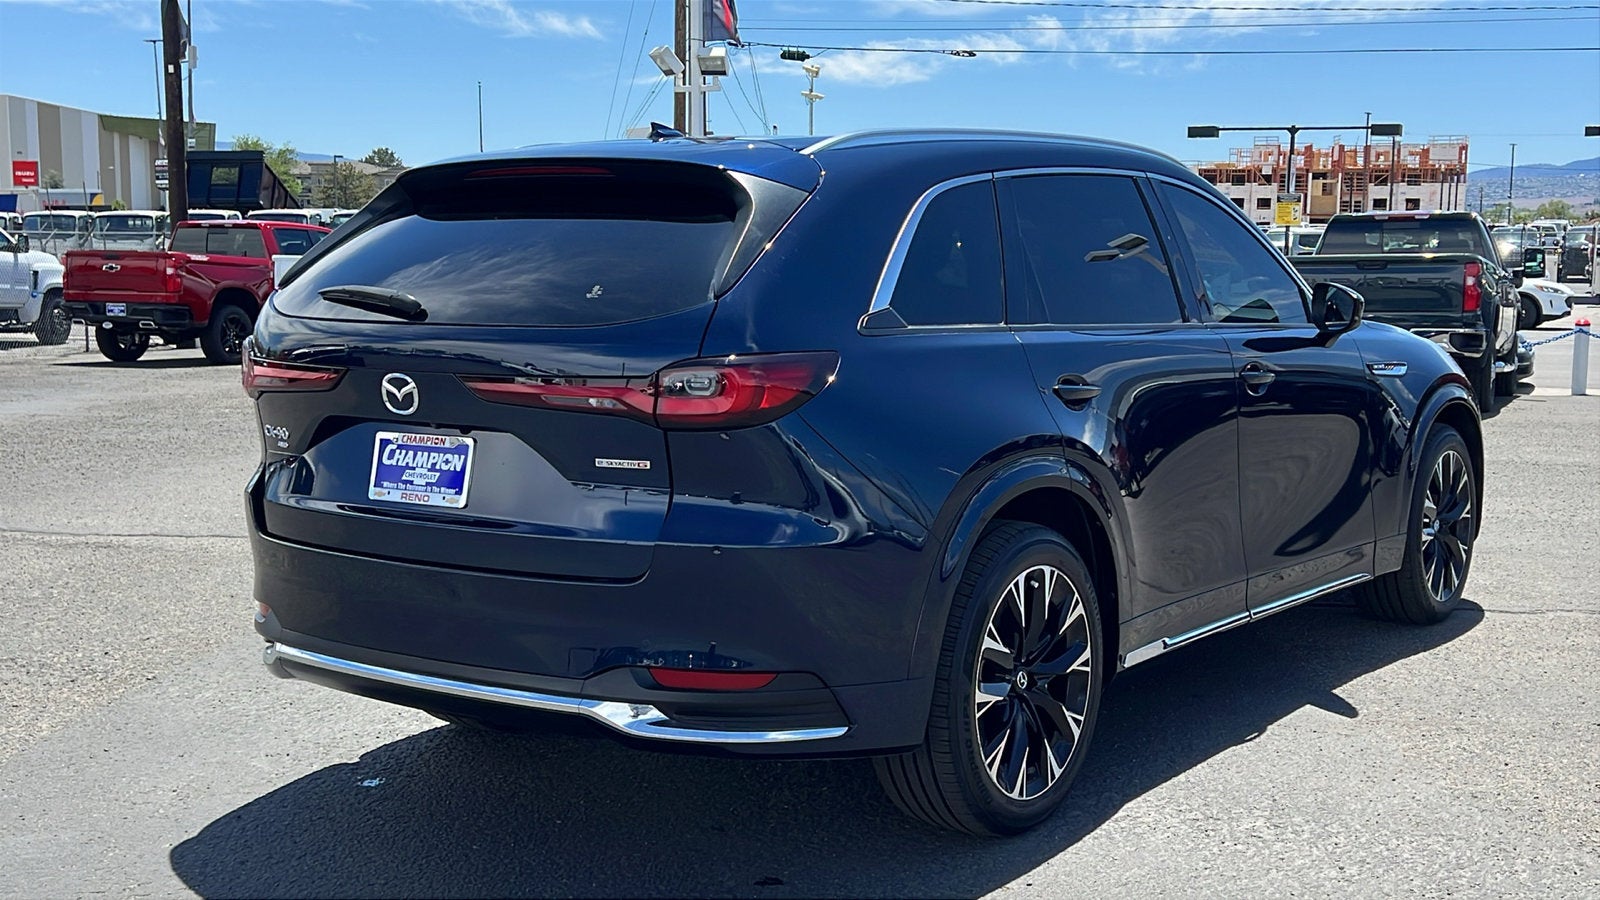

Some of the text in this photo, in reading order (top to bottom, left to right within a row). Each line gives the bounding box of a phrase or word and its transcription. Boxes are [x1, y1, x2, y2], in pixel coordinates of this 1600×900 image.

[401, 434, 447, 446] CHAMPION
[382, 443, 465, 472] CHAMPION
[404, 471, 438, 481] CHEVROLET
[400, 492, 430, 503] RENO
